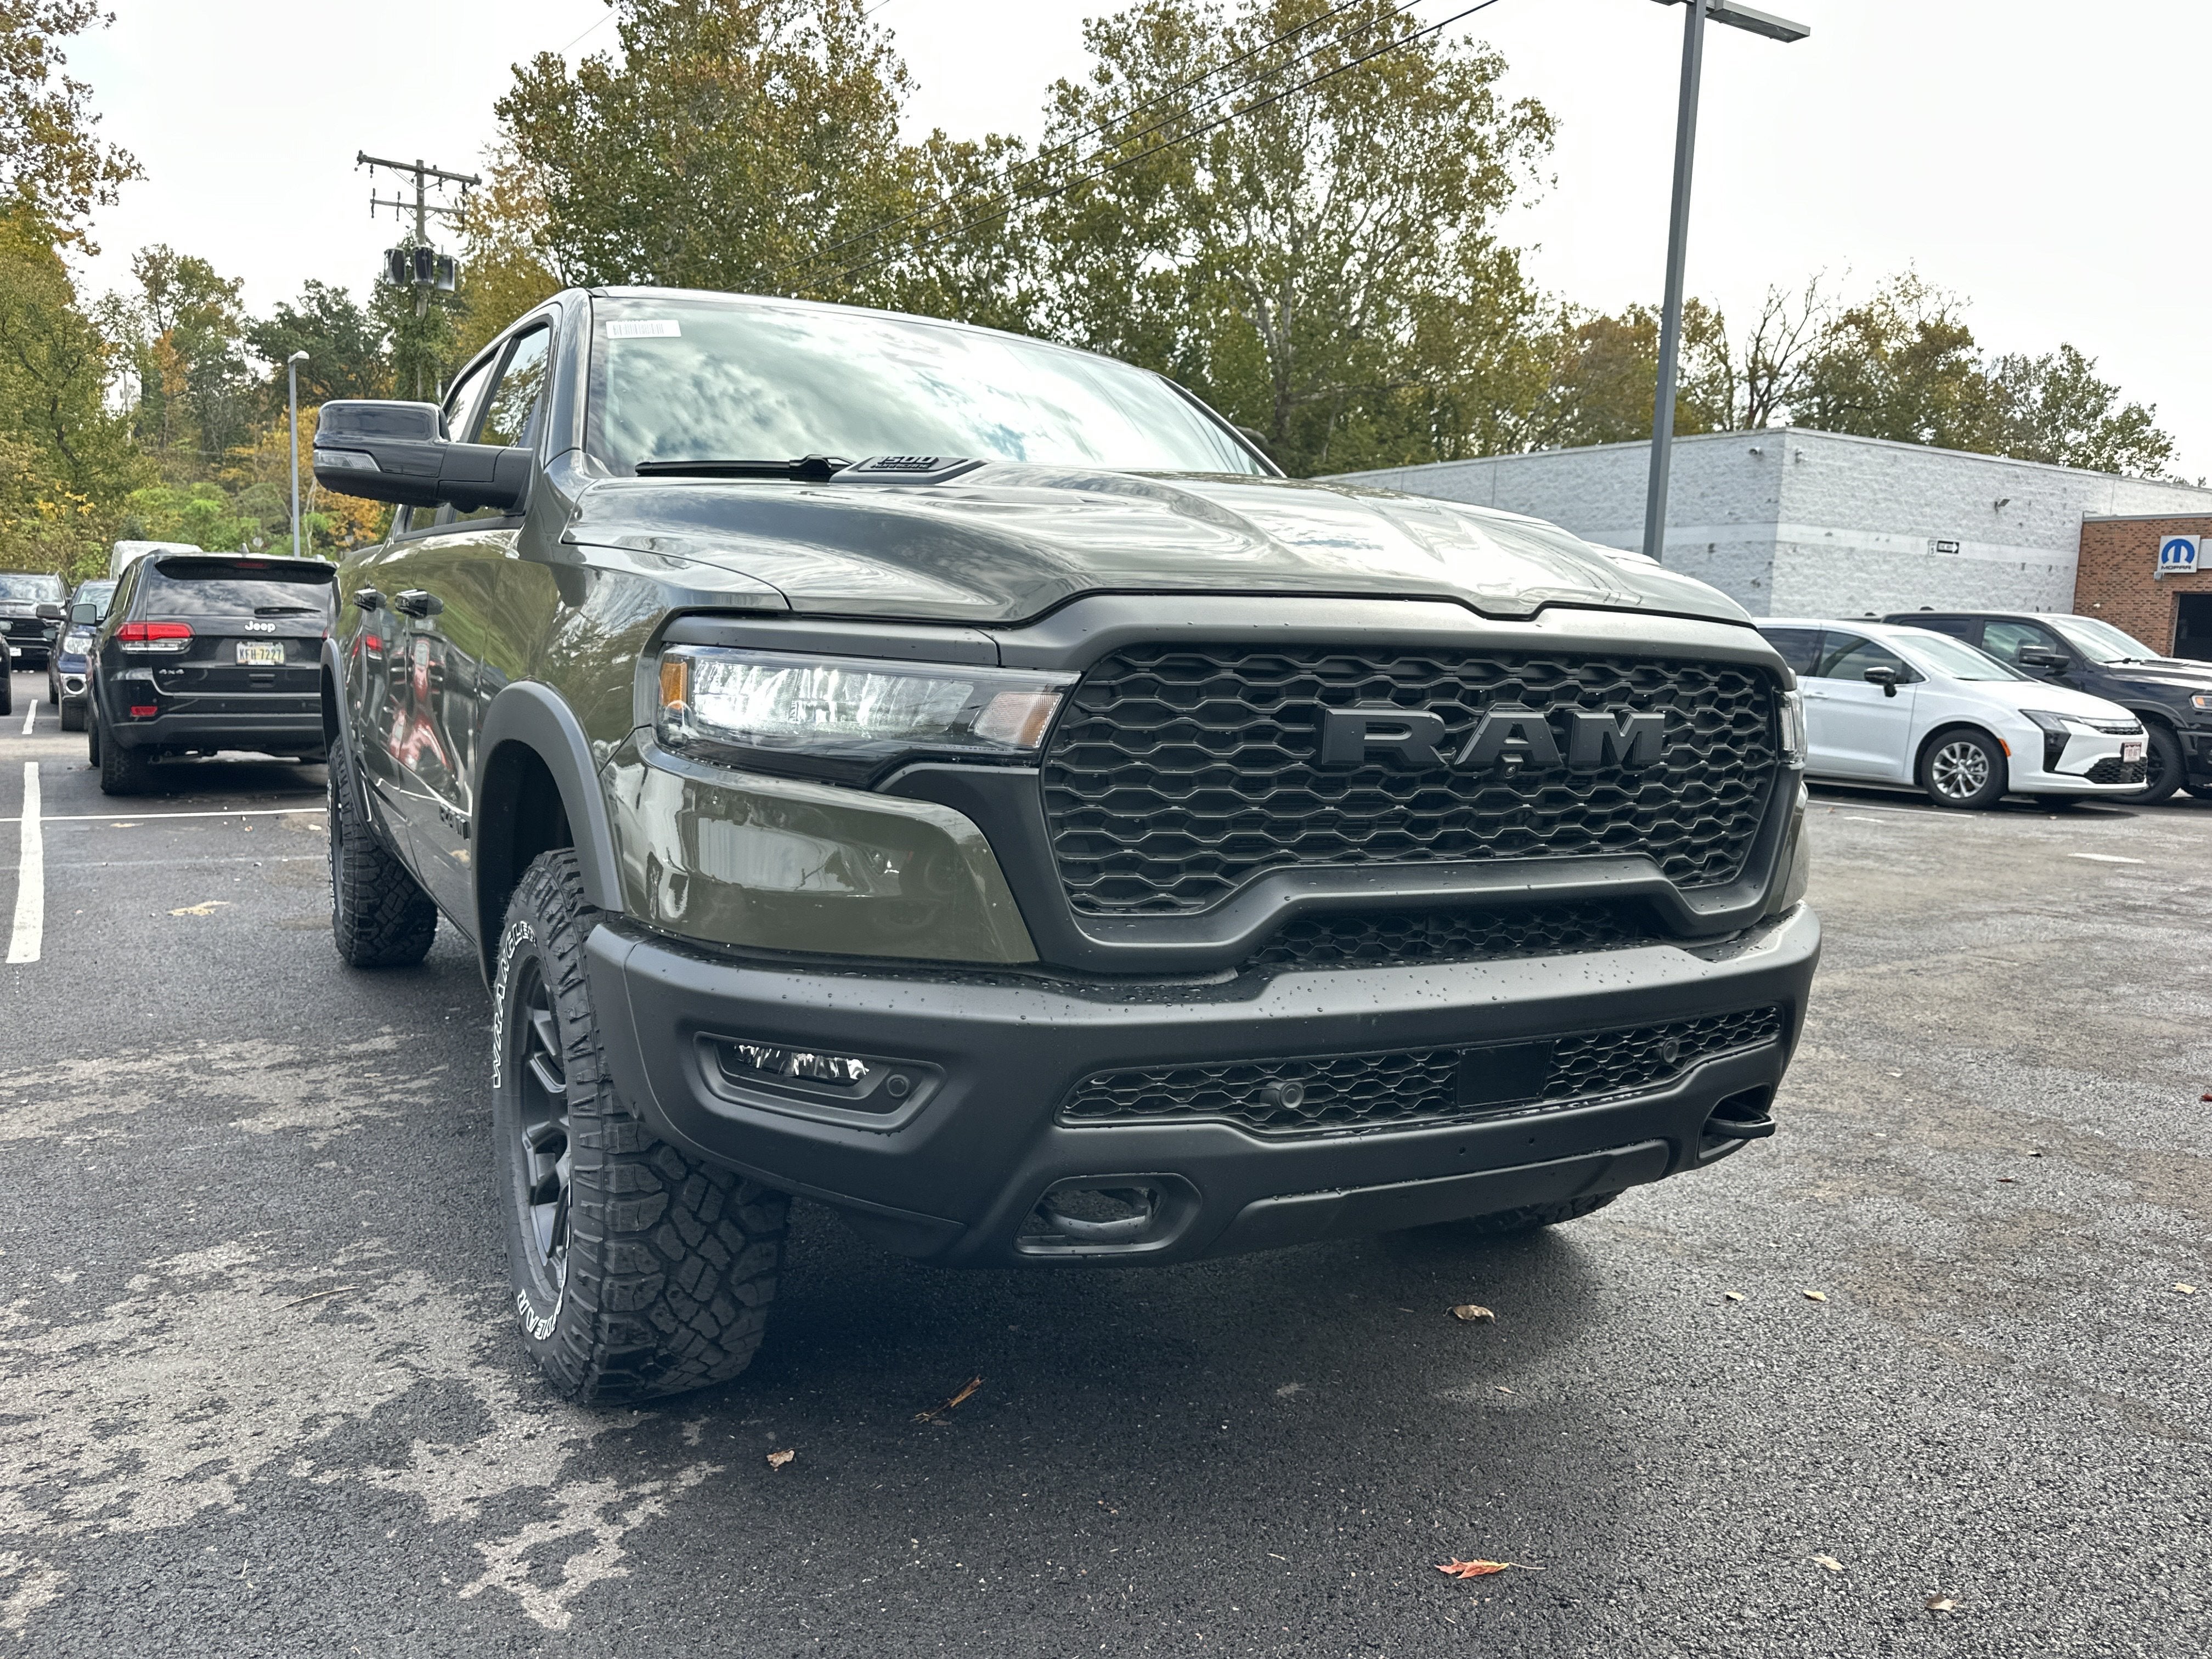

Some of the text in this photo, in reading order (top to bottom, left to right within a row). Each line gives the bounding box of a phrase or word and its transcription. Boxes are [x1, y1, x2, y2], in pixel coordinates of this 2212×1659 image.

[245, 620, 276, 633] Jeep
[1322, 709, 1666, 766] RAM
[439, 804, 472, 840] RAM
[493, 920, 537, 1088] WRANGLER
